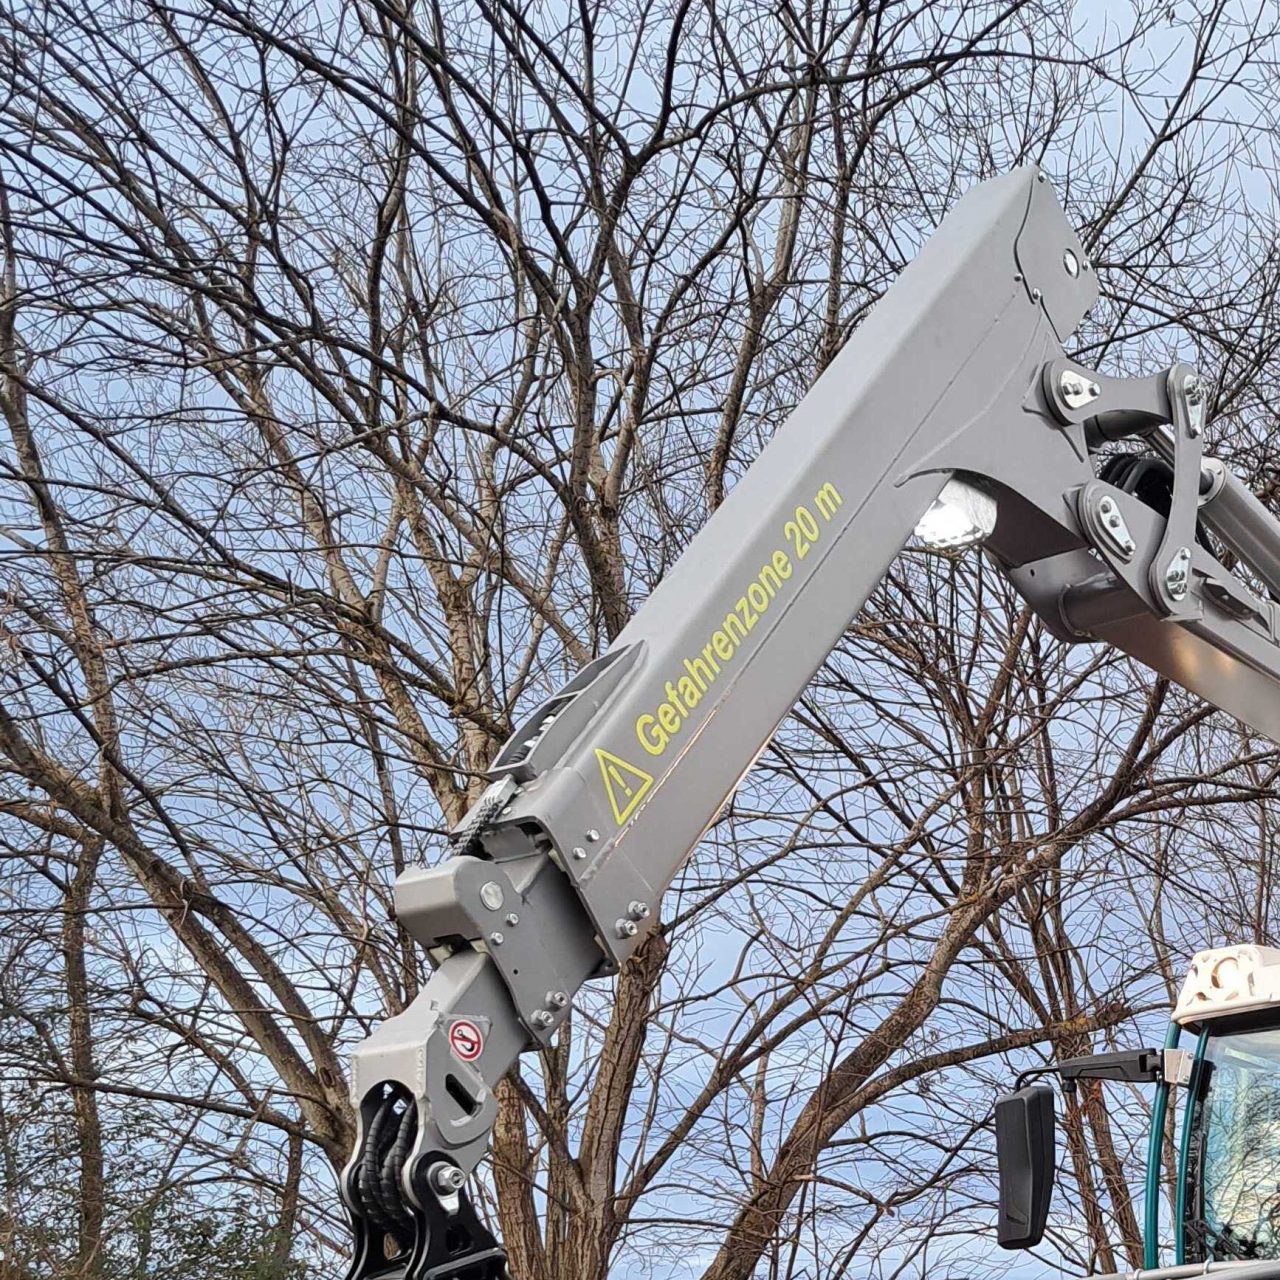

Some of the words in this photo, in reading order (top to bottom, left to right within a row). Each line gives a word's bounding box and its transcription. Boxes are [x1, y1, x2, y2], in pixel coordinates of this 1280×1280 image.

[635, 549, 794, 757] Gefahrenzone
[783, 505, 821, 560] 20
[813, 481, 844, 523] m
